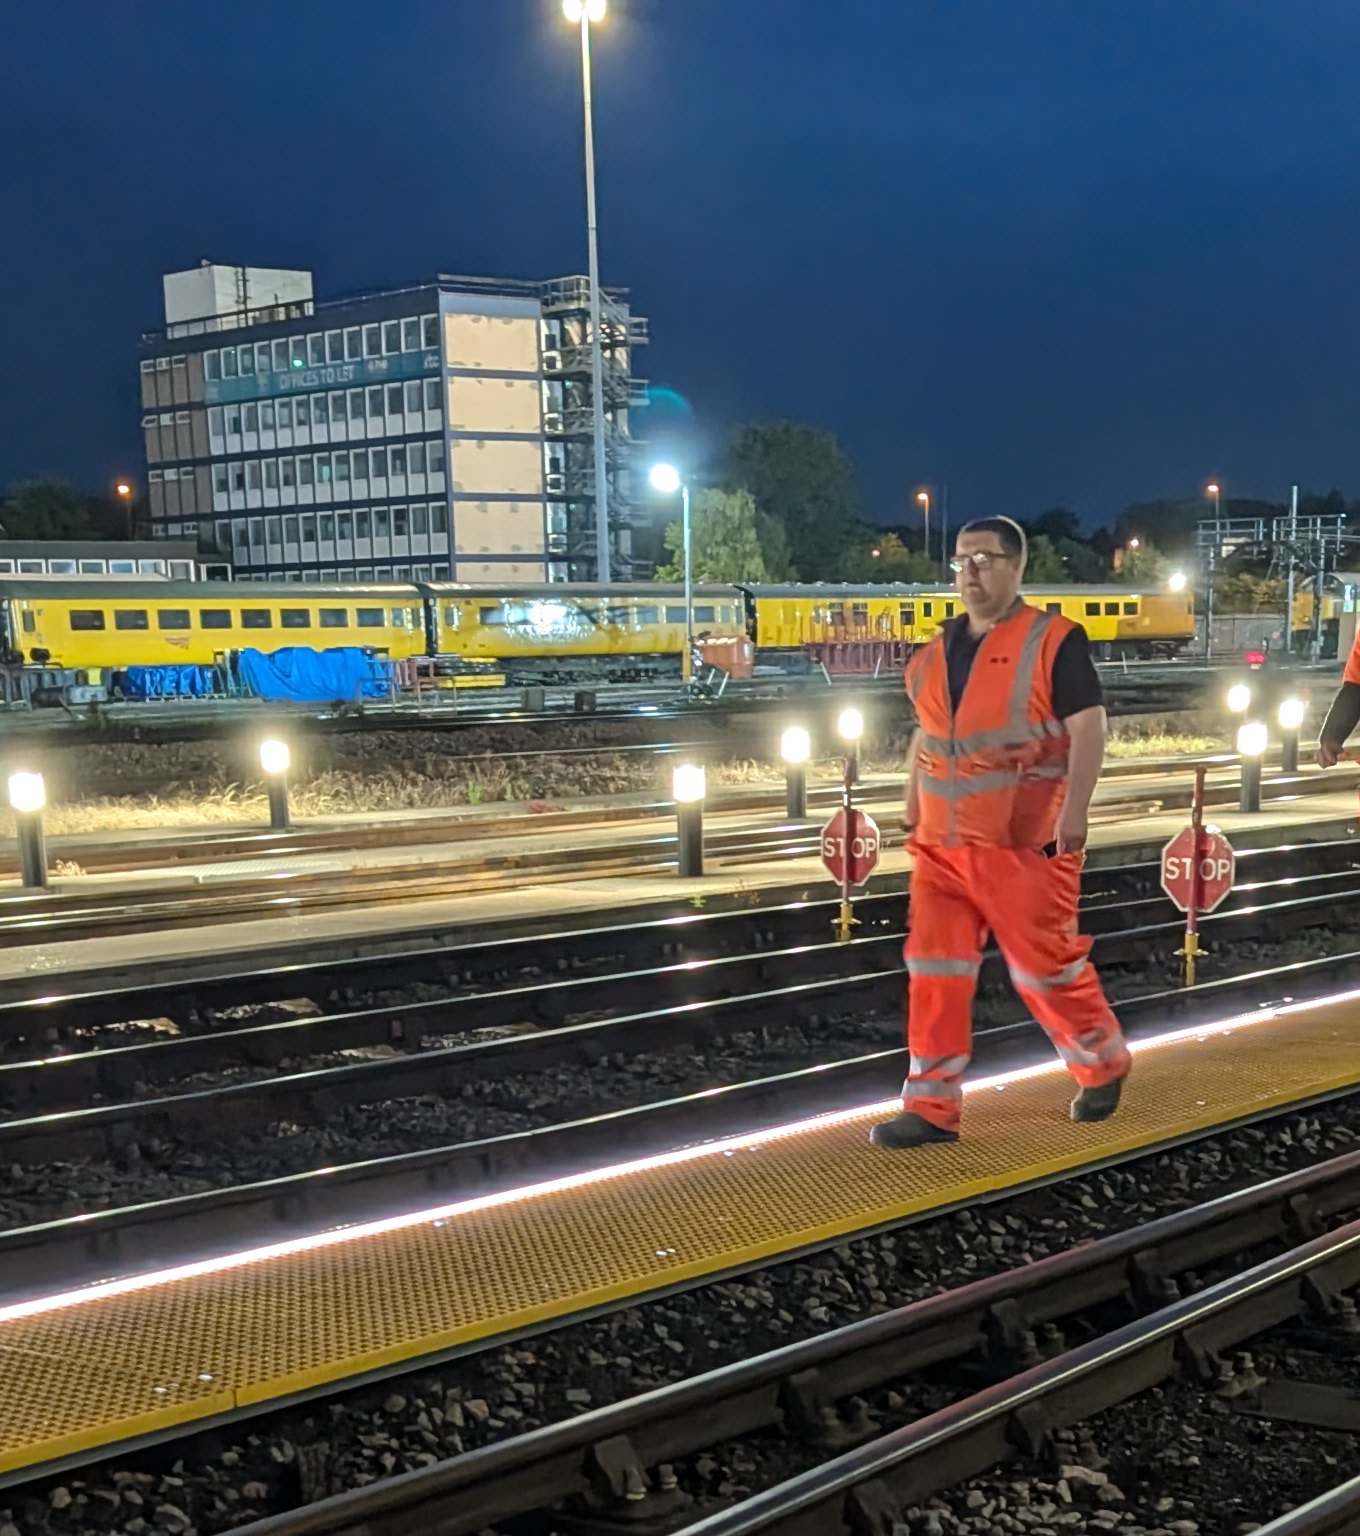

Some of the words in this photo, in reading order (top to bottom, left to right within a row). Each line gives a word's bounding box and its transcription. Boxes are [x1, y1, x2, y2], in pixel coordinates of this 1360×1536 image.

[279, 369, 319, 390] OFFICES
[321, 367, 335, 385] TO
[336, 364, 355, 383] LET
[824, 837, 876, 858] STOP
[1165, 857, 1231, 881] STOP
